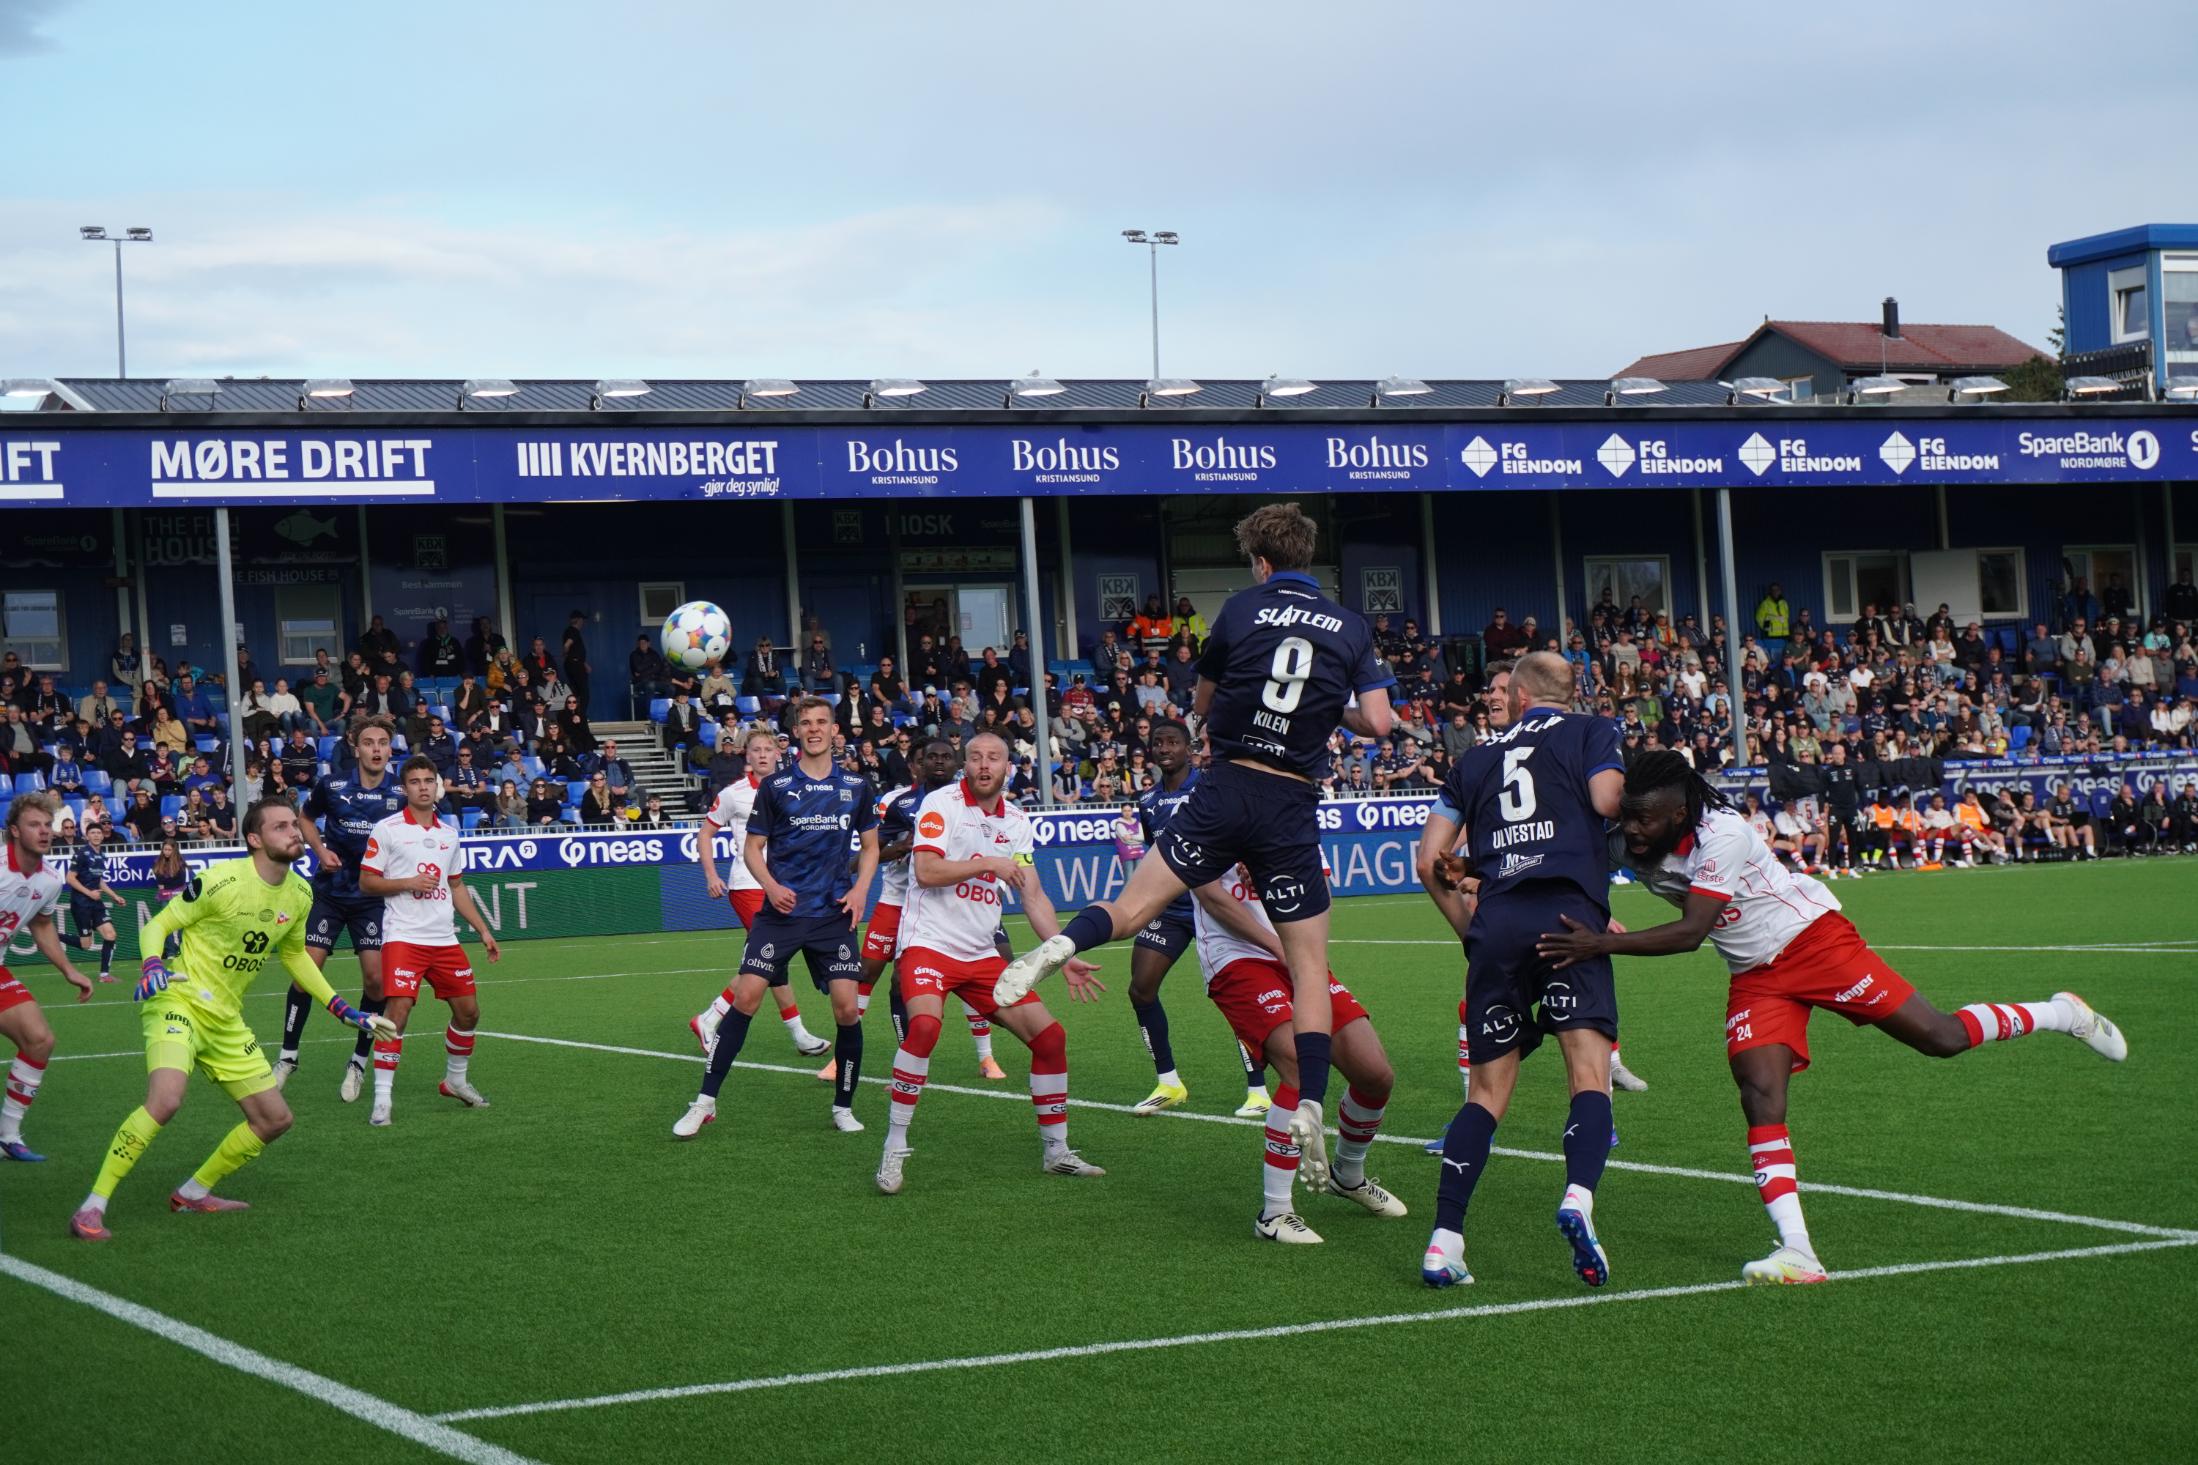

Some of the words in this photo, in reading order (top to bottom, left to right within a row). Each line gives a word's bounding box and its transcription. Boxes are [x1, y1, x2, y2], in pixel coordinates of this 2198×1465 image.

[1171, 436, 1277, 470] Bohus
[1326, 435, 1429, 468] Bohus
[1501, 442, 1527, 459] FG
[1639, 440, 1666, 458] FG
[1780, 440, 1806, 457] FG
[1919, 438, 1946, 456] FG
[2019, 431, 2125, 457] SpareBank
[151, 438, 290, 481] MØRE
[300, 439, 432, 479] DRIFT
[570, 441, 778, 476] KVERNBERGET
[847, 438, 958, 472] Bohus
[1011, 437, 1120, 471] Bohus
[2061, 457, 2127, 469] NORDMØRE
[1502, 459, 1582, 475] EIENDOM
[1640, 458, 1722, 474] EIENDOM
[1781, 457, 1861, 472] EIENDOM
[1920, 456, 1999, 471] EIENDOM
[872, 476, 938, 484] KRISTIANSUND
[1035, 474, 1100, 483] KRISTIANSUND
[1195, 472, 1257, 481] KRISTIANSUND
[1349, 471, 1410, 480] KRISTIANSUND
[727, 479, 746, 496] deg
[747, 477, 780, 496] synlig!
[192, 516, 240, 535] FIH
[1261, 636, 1314, 714] 9
[1252, 710, 1291, 736] KILEN
[1498, 746, 1537, 822] 5
[790, 815, 839, 828] SpareBank
[1316, 808, 1342, 829] as
[1382, 804, 1430, 827] nea
[1492, 819, 1555, 849] ULVESTAD
[589, 839, 665, 864] neas
[413, 888, 447, 901] OBOS
[1265, 884, 1305, 901] ALTI
[829, 961, 859, 973] olivita
[1541, 995, 1577, 1009] ALTI
[1482, 1012, 1523, 1036] ALTI
[1736, 1023, 1753, 1042] 24
